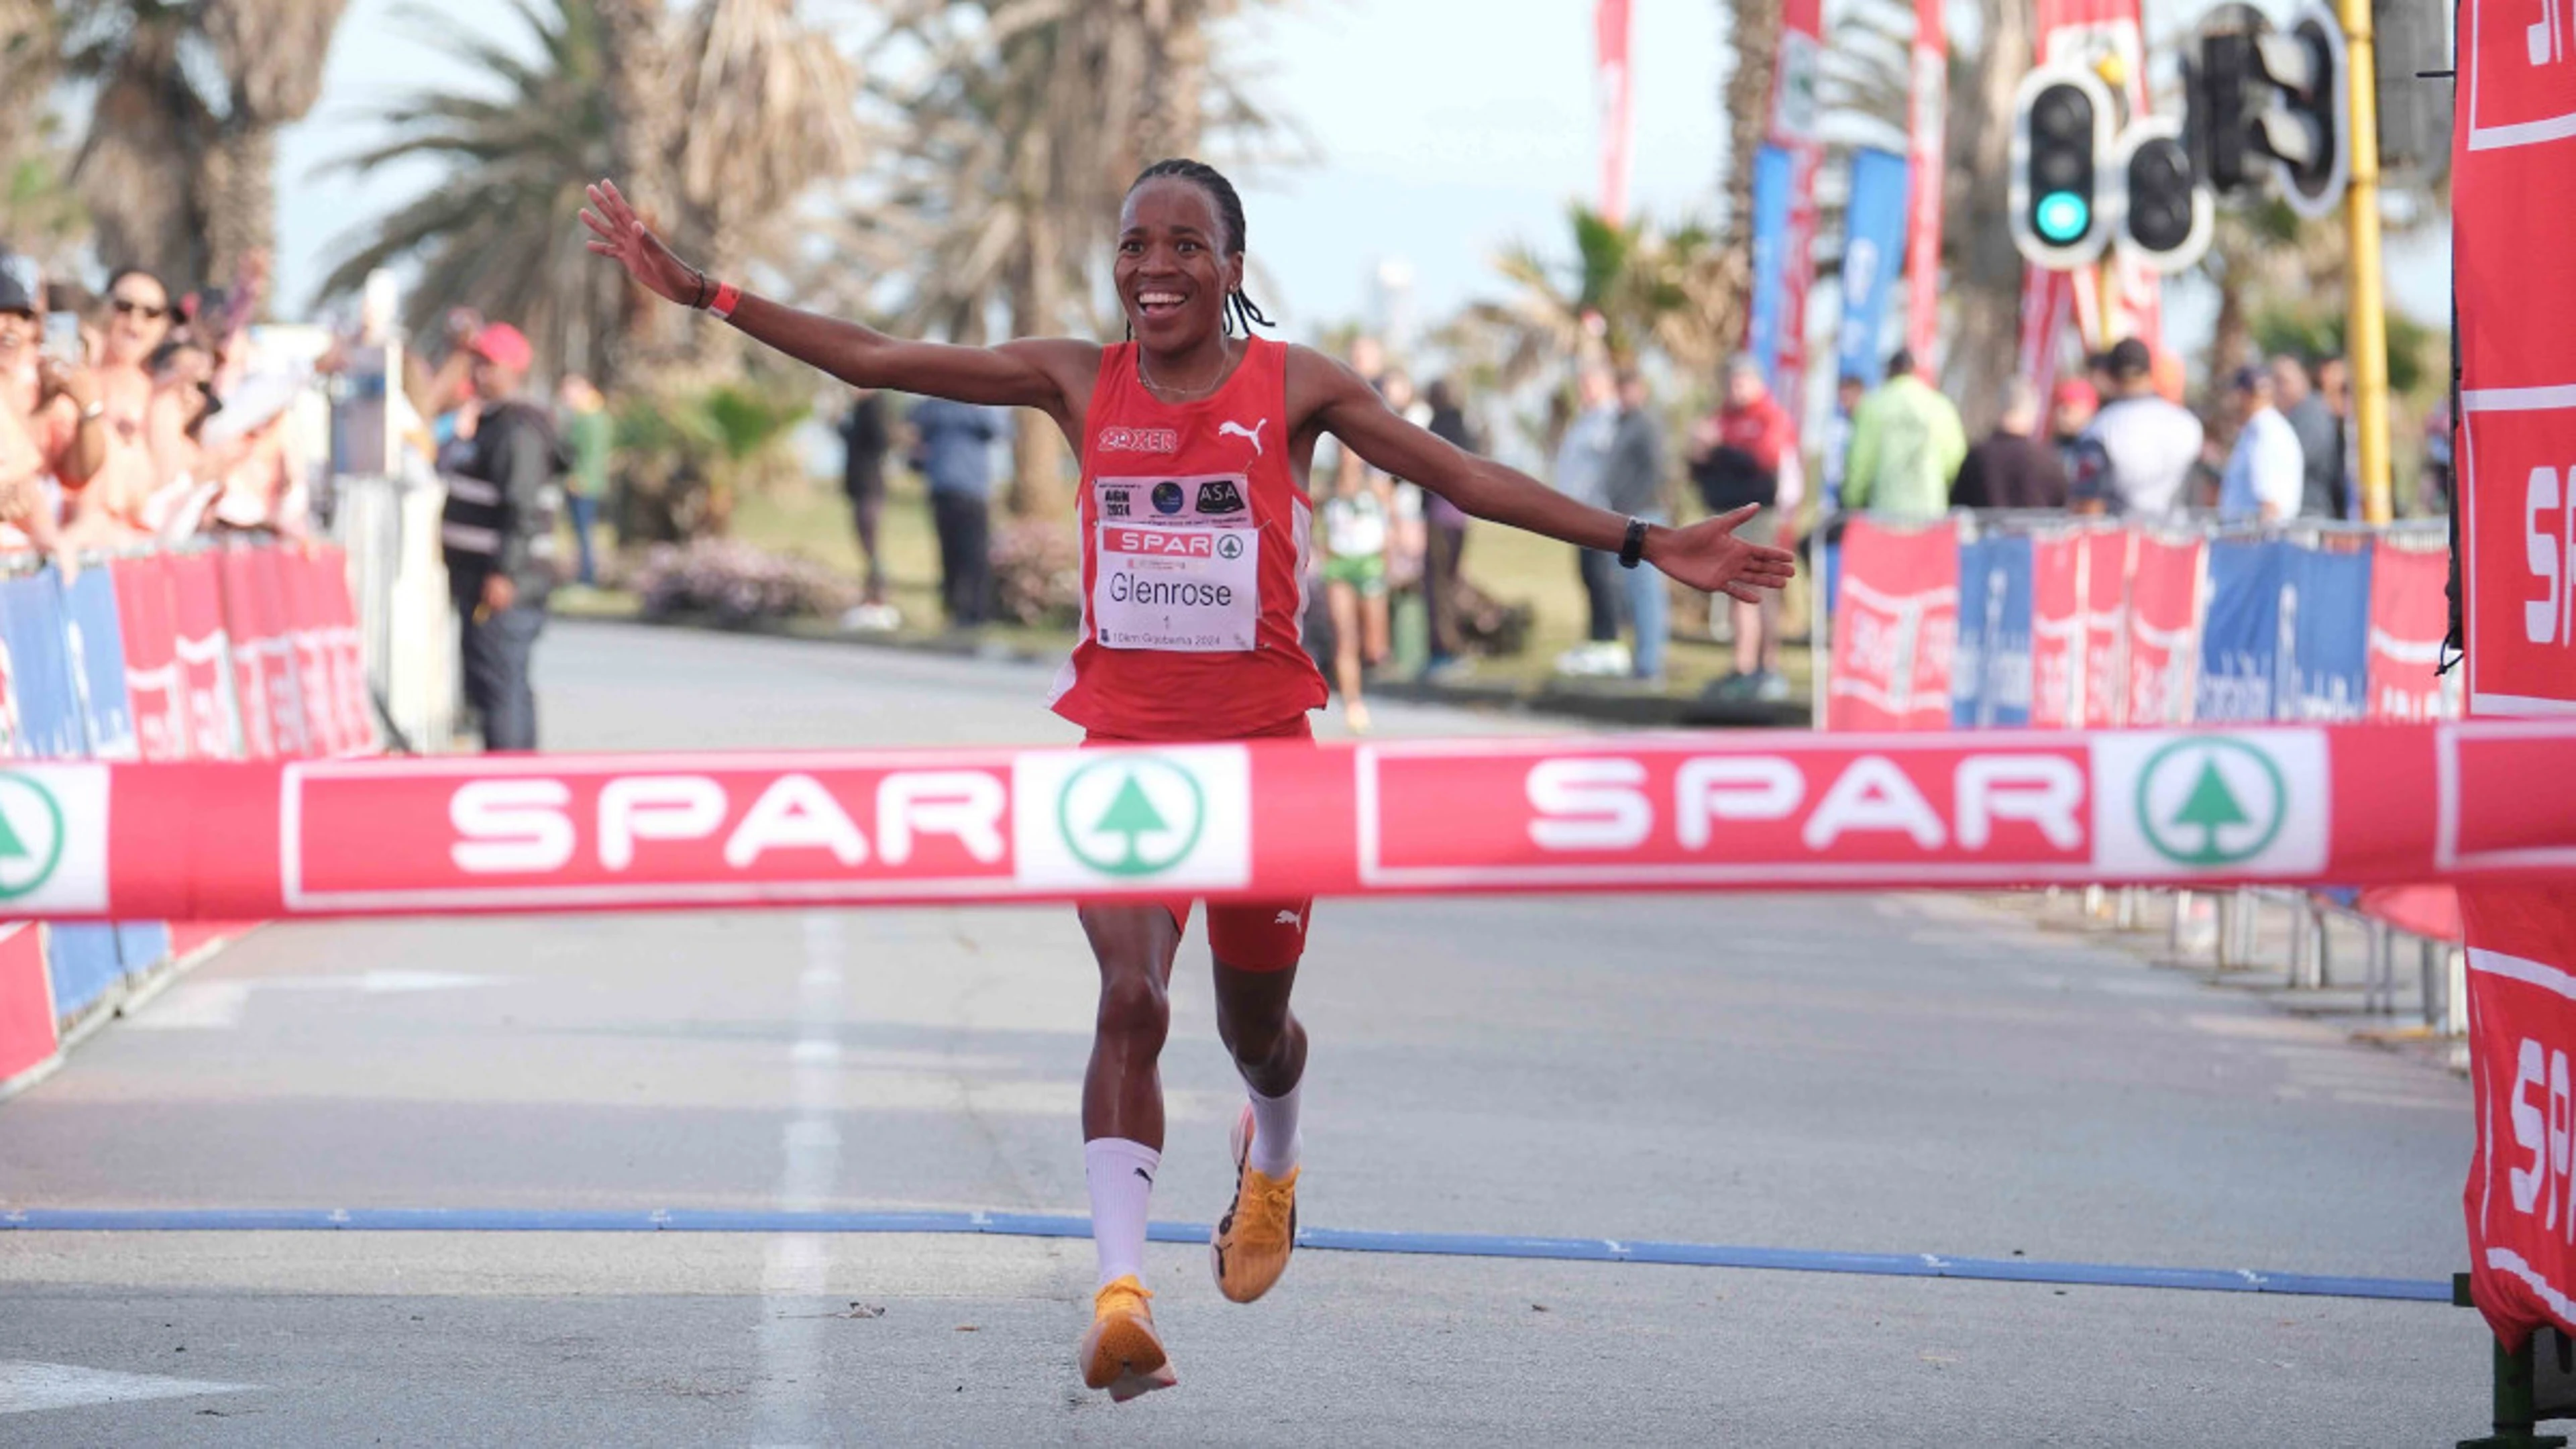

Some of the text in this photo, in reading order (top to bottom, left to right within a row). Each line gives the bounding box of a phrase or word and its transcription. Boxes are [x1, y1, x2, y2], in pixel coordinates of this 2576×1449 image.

[1199, 484, 1237, 502] ASA
[1121, 531, 1210, 554] SPAR
[1110, 572, 1232, 606] Glenrose
[1524, 754, 2085, 852] SPAR
[448, 769, 1007, 874] SPAR
